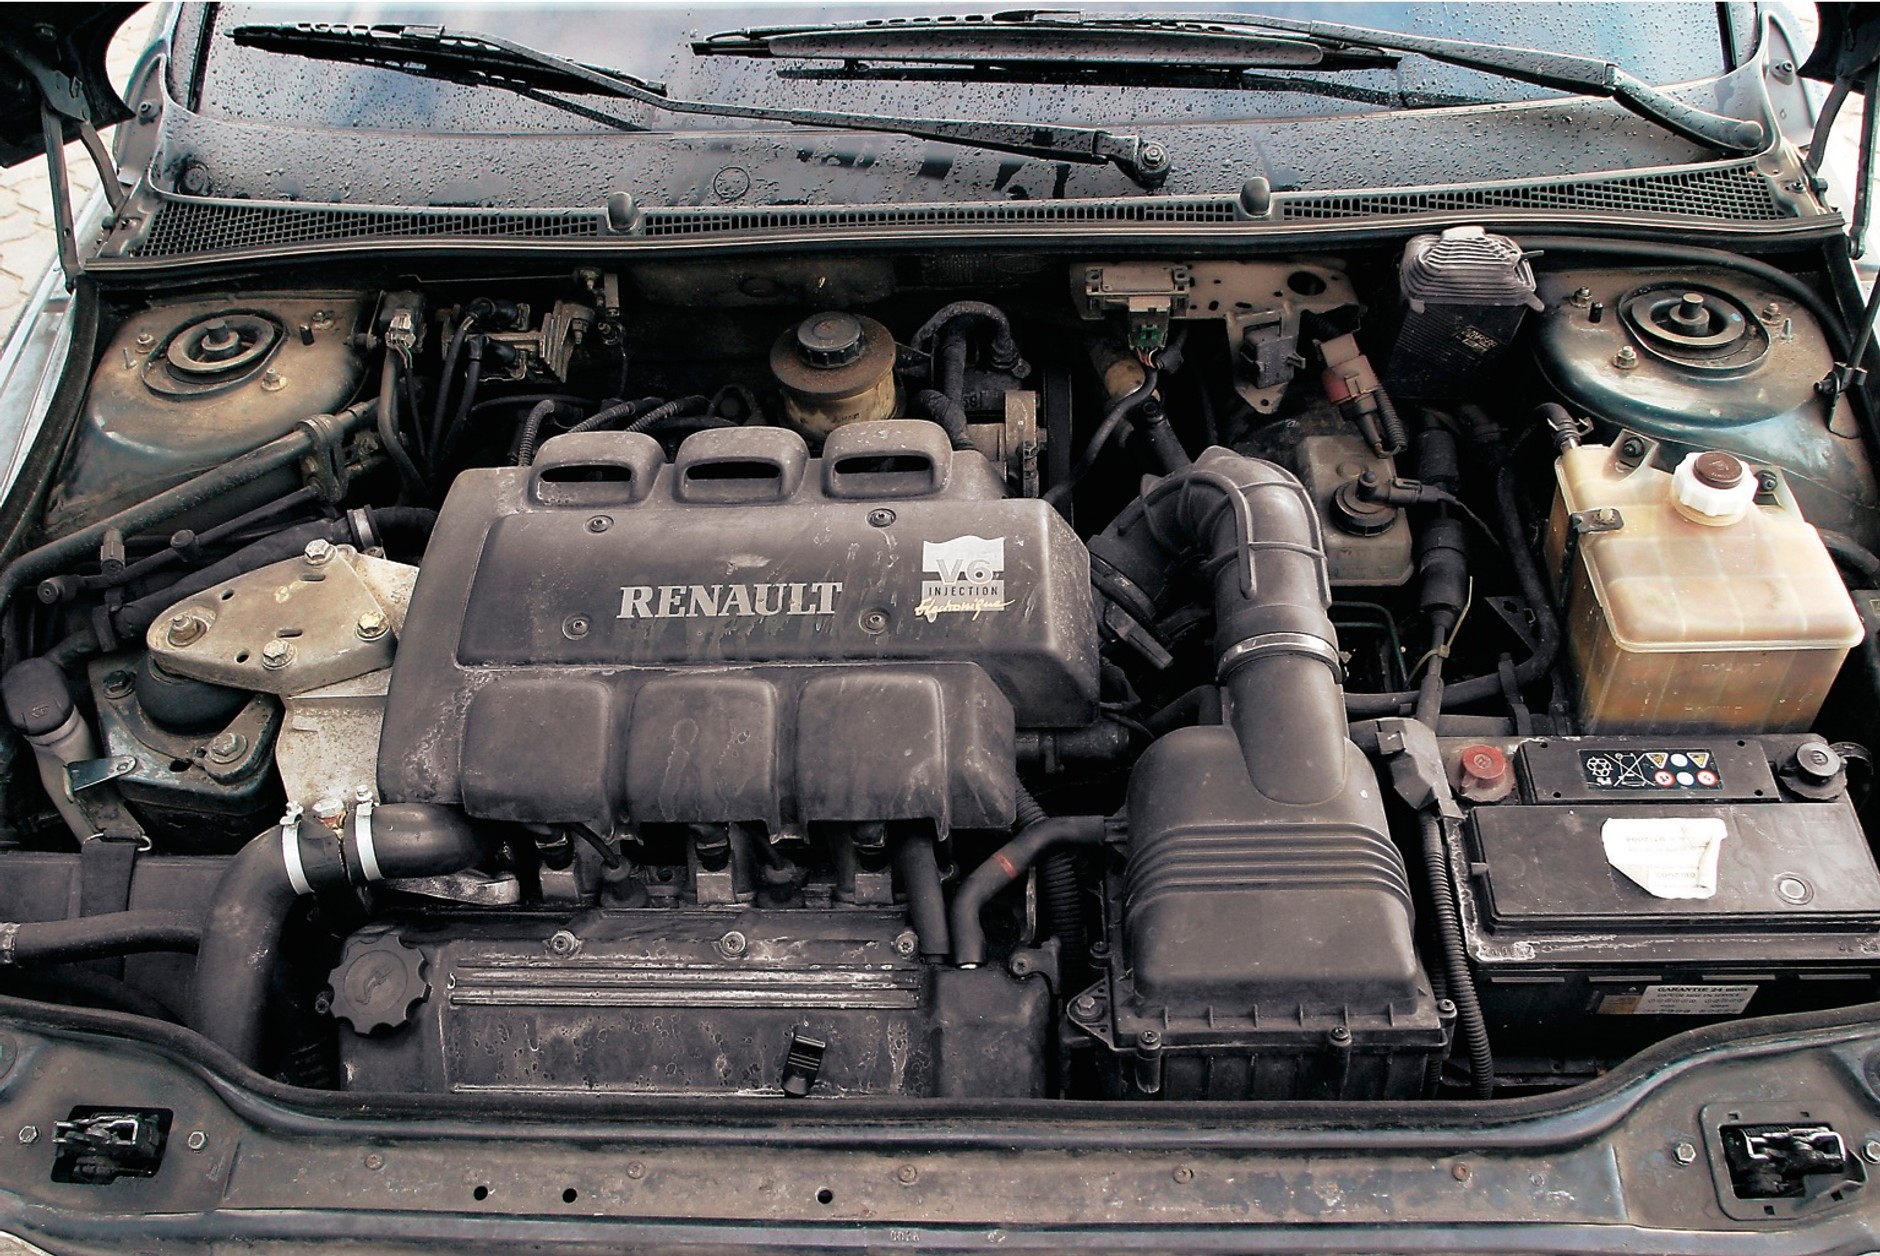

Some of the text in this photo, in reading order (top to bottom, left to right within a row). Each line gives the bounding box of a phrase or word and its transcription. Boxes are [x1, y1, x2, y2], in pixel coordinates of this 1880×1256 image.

[935, 558, 994, 585] V6
[616, 582, 843, 619] RENAULT
[928, 586, 998, 597] INJECTION
